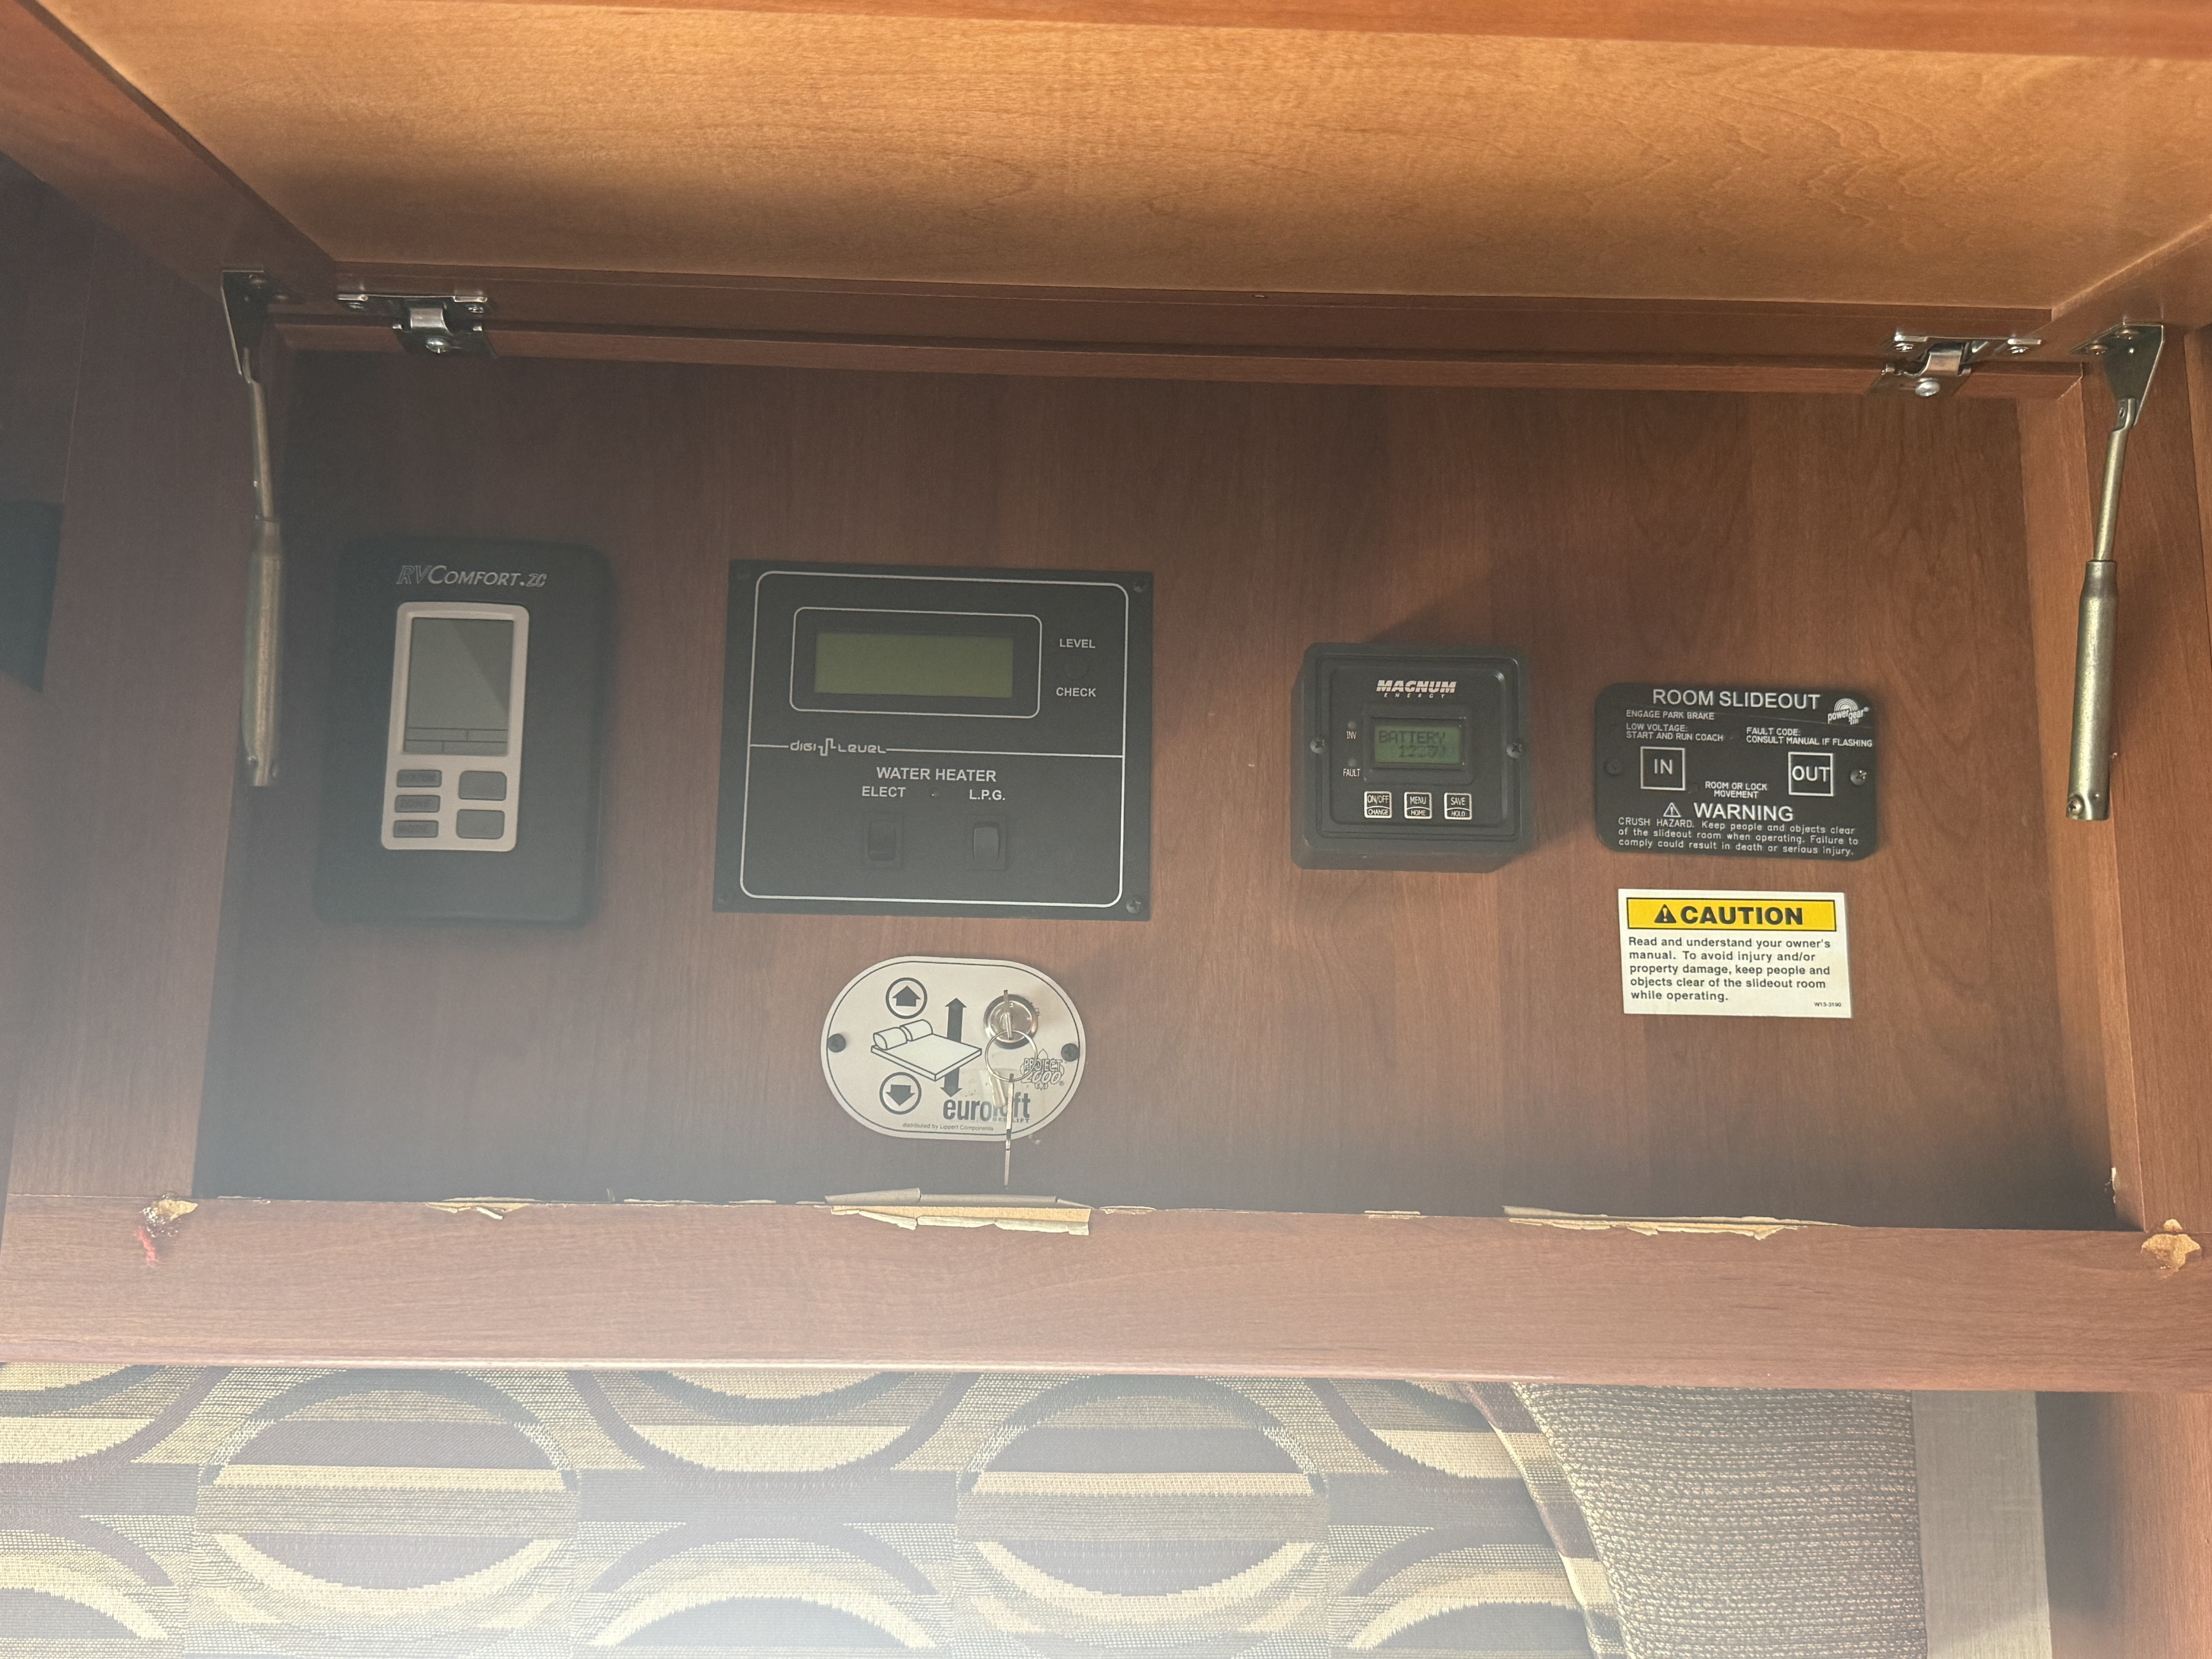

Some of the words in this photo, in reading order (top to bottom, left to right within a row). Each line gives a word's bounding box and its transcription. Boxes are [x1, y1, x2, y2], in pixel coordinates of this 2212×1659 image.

[1059, 638, 1095, 649] LEVEL
[1056, 687, 1097, 698] CHECK
[1376, 680, 1457, 693] MAGNUM
[1653, 688, 1713, 706] ROOM
[1719, 691, 1820, 710] SLIDEOUT
[1626, 709, 1660, 718] ENGAGE
[1662, 711, 1684, 719] PARK
[1687, 712, 1715, 720] BRAKE
[1626, 722, 1644, 731] LOW
[1647, 723, 1688, 732] VOLTAGE:
[1746, 727, 1773, 735] FAULT
[1776, 728, 1801, 736] CODE:
[1346, 731, 1357, 739] INV
[1379, 731, 1446, 744] BATTERY
[1626, 731, 1654, 739] START
[1656, 732, 1673, 740] AND
[1695, 733, 1723, 742] COACH
[1746, 735, 1783, 744] CONSULT
[1786, 737, 1820, 745] MANUAL
[1832, 738, 1873, 747] FLASHING
[1343, 768, 1360, 777] FAULT
[1654, 759, 1673, 774] IN
[876, 766, 930, 780] WATER
[936, 768, 997, 782] HEATER
[1791, 765, 1830, 782] OUT
[862, 785, 906, 797] ELECT
[1704, 781, 1730, 790] ROOM
[1731, 782, 1743, 790] OR
[1745, 782, 1767, 791] LOCK
[969, 788, 1006, 801] L.P.G.
[1367, 794, 1390, 805] ON/OFF
[1410, 796, 1427, 805] MENU
[1713, 790, 1759, 799] MOVEMENT
[1451, 797, 1465, 806] SAVE
[1693, 802, 1794, 821] WARNING
[1618, 817, 1650, 826] CRUSH
[1656, 818, 1694, 828] HAZARD.
[1702, 821, 1725, 831] Keep
[1730, 823, 1762, 832] people
[1767, 823, 1785, 832] and
[1790, 824, 1826, 834] objects
[1830, 826, 1856, 834] clear
[1633, 828, 1648, 836] the
[1653, 829, 1692, 838] slideout
[1726, 832, 1751, 841] when
[1755, 834, 1805, 844] operating.
[1810, 834, 1844, 844] Failure
[1849, 837, 1859, 846] to
[1618, 838, 1653, 848] comply
[1657, 839, 1684, 848] could
[1688, 841, 1717, 849] result
[1735, 843, 1762, 851] death
[1782, 845, 1818, 854] serious
[1823, 846, 1854, 857] injury.
[1680, 905, 1804, 926] CAUTION
[1628, 937, 1657, 947] Read
[1661, 937, 1683, 947] and
[1686, 938, 1752, 948] understand
[1756, 940, 1782, 950] your
[1785, 939, 1830, 949] owner's
[1629, 950, 1676, 960] manual.
[1683, 951, 1697, 960] To
[1700, 951, 1733, 961] avoid
[1738, 951, 1772, 963] injury
[1776, 952, 1815, 962] and/or
[1630, 964, 1678, 975] property
[1682, 964, 1732, 975] damage,
[1735, 965, 1763, 977] keep
[1766, 966, 1806, 977] people
[1809, 966, 1830, 975] and
[1630, 977, 1673, 988] objects
[1676, 977, 1705, 987] clear
[1708, 978, 1720, 987] of
[1724, 978, 1742, 988] the
[1745, 978, 1793, 988] slideout
[1796, 980, 1826, 989] room
[1631, 990, 1662, 1000] while
[1666, 992, 1729, 1003] operating.
[1024, 1057, 1063, 1072] PROJECT
